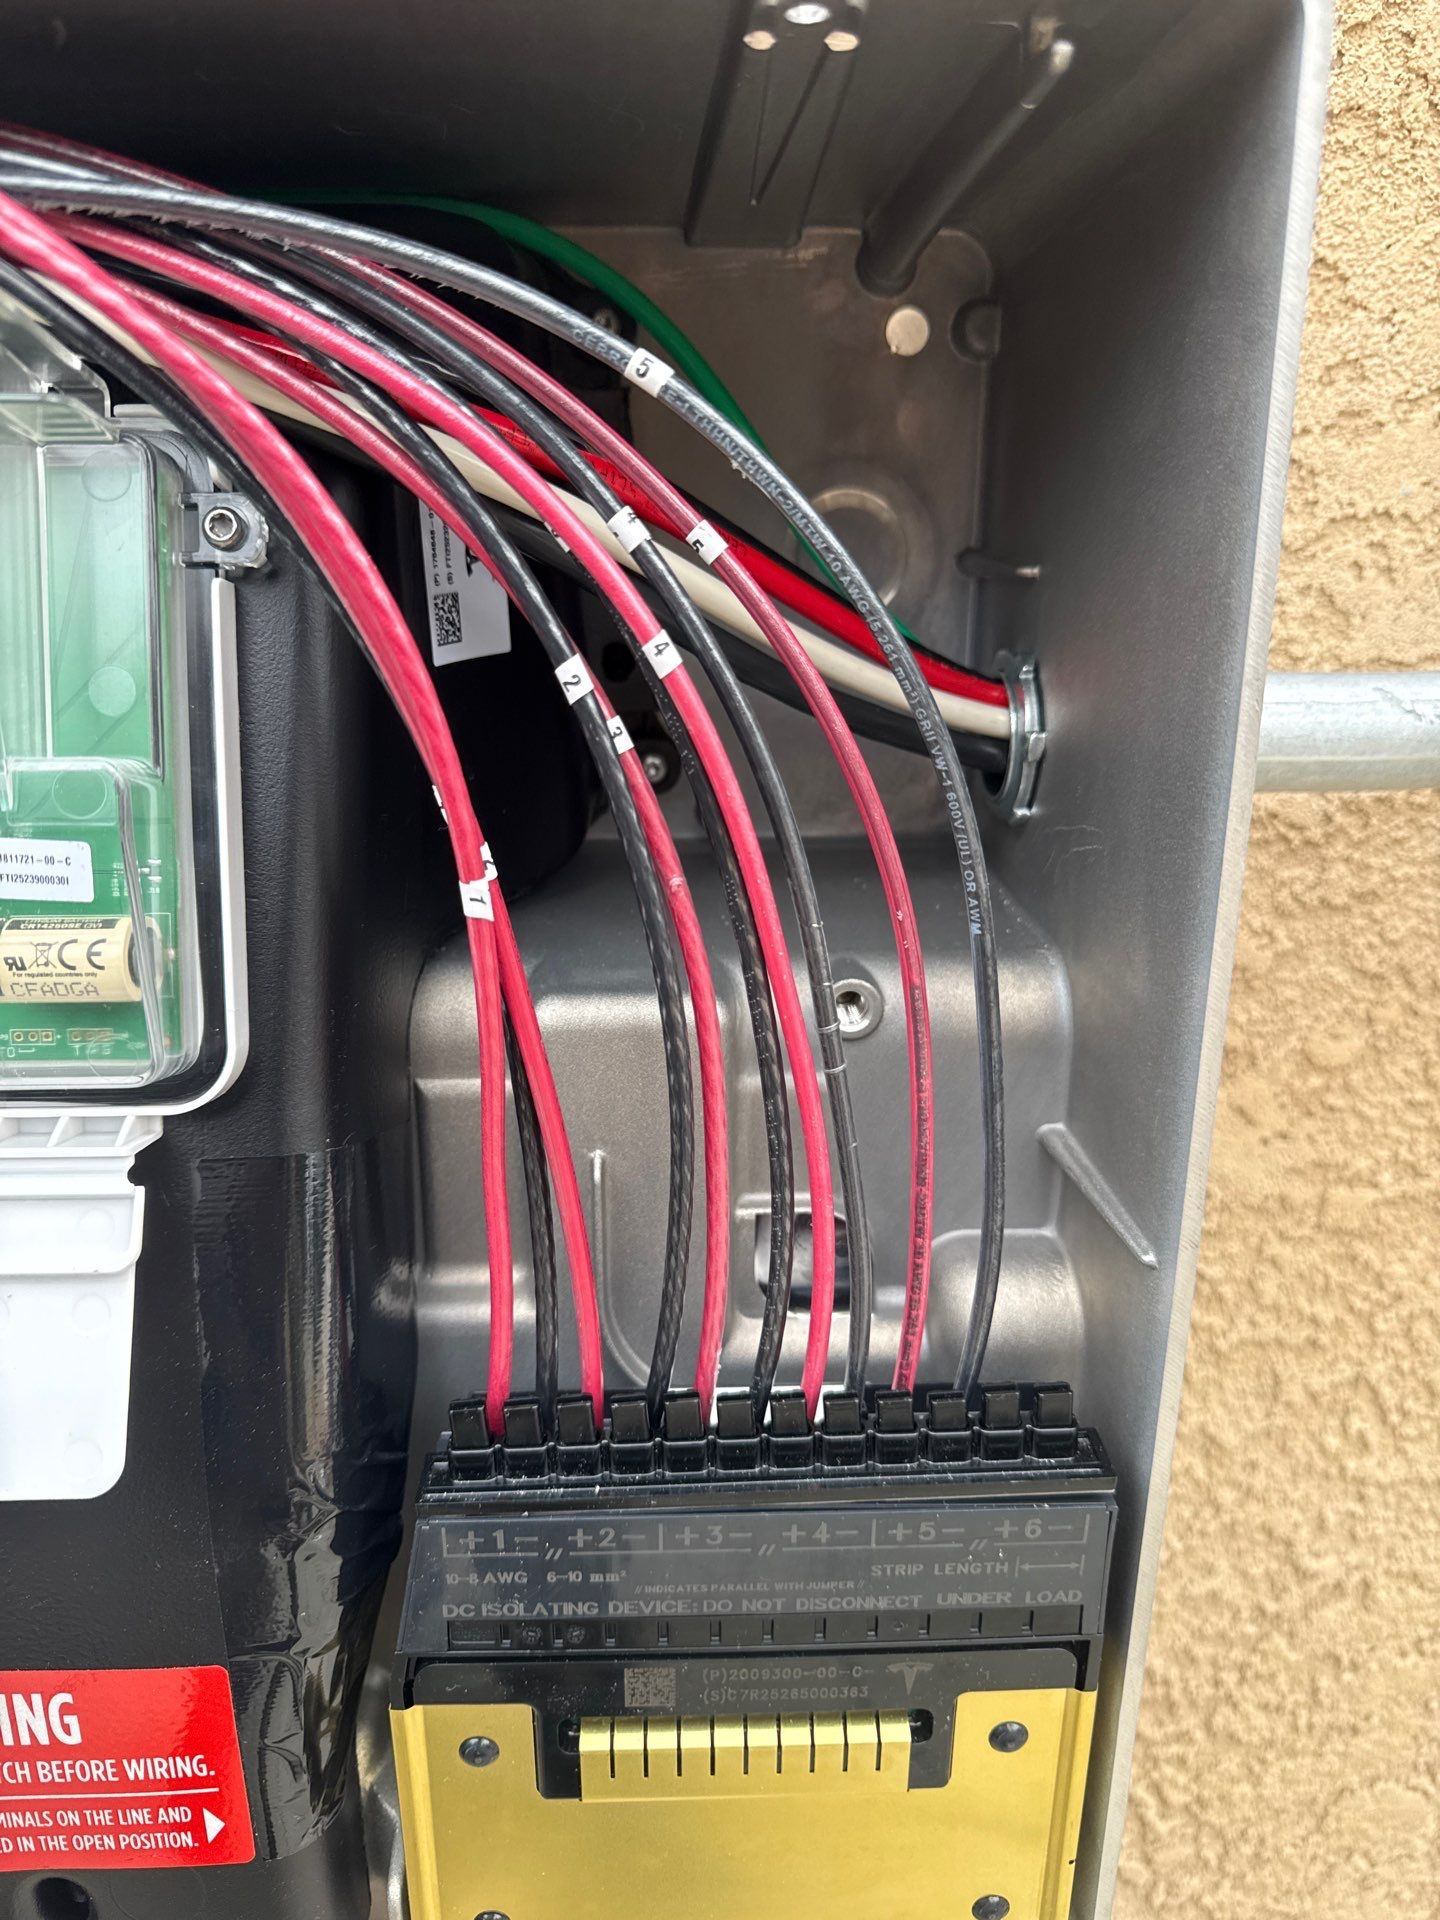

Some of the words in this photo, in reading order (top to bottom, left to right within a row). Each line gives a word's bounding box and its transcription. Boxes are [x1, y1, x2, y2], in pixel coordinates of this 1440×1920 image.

[635, 357, 653, 378] 5
[841, 575, 870, 614] AWG
[654, 641, 670, 657] 4
[563, 674, 581, 692] 2
[930, 745, 952, 787] VW-1
[944, 791, 965, 830] 600V
[955, 833, 973, 865] (UL)
[963, 869, 976, 892] OR
[483, 1571, 528, 1584] AWG
[871, 1563, 924, 1577] STRIP
[934, 1561, 1009, 1576] LENGTH
[644, 1584, 708, 1593] INDICATES
[710, 1583, 770, 1592] PARALLEL
[774, 1582, 804, 1591] WITH
[806, 1580, 855, 1590] JUMPER
[442, 1603, 475, 1618] DC
[482, 1601, 599, 1617] ISOLATING
[608, 1600, 698, 1616] DEVICE:
[703, 1599, 733, 1613] DO
[742, 1598, 787, 1612] NOT
[795, 1595, 922, 1611] DISCONNECT
[937, 1592, 1012, 1606] UNDER
[1025, 1589, 1083, 1603] LOAD
[0, 1761, 32, 1785] CH
[36, 1758, 120, 1783] BEFORE
[122, 1754, 216, 1781] WIRING.
[56, 1810, 81, 1827] ON
[83, 1809, 115, 1826] THE
[117, 1808, 153, 1825] LINE
[157, 1806, 192, 1824] AND
[16, 1835, 36, 1852] IN
[37, 1834, 70, 1851] THE
[71, 1833, 116, 1850] OPEN
[118, 1830, 199, 1850] POSITION.
